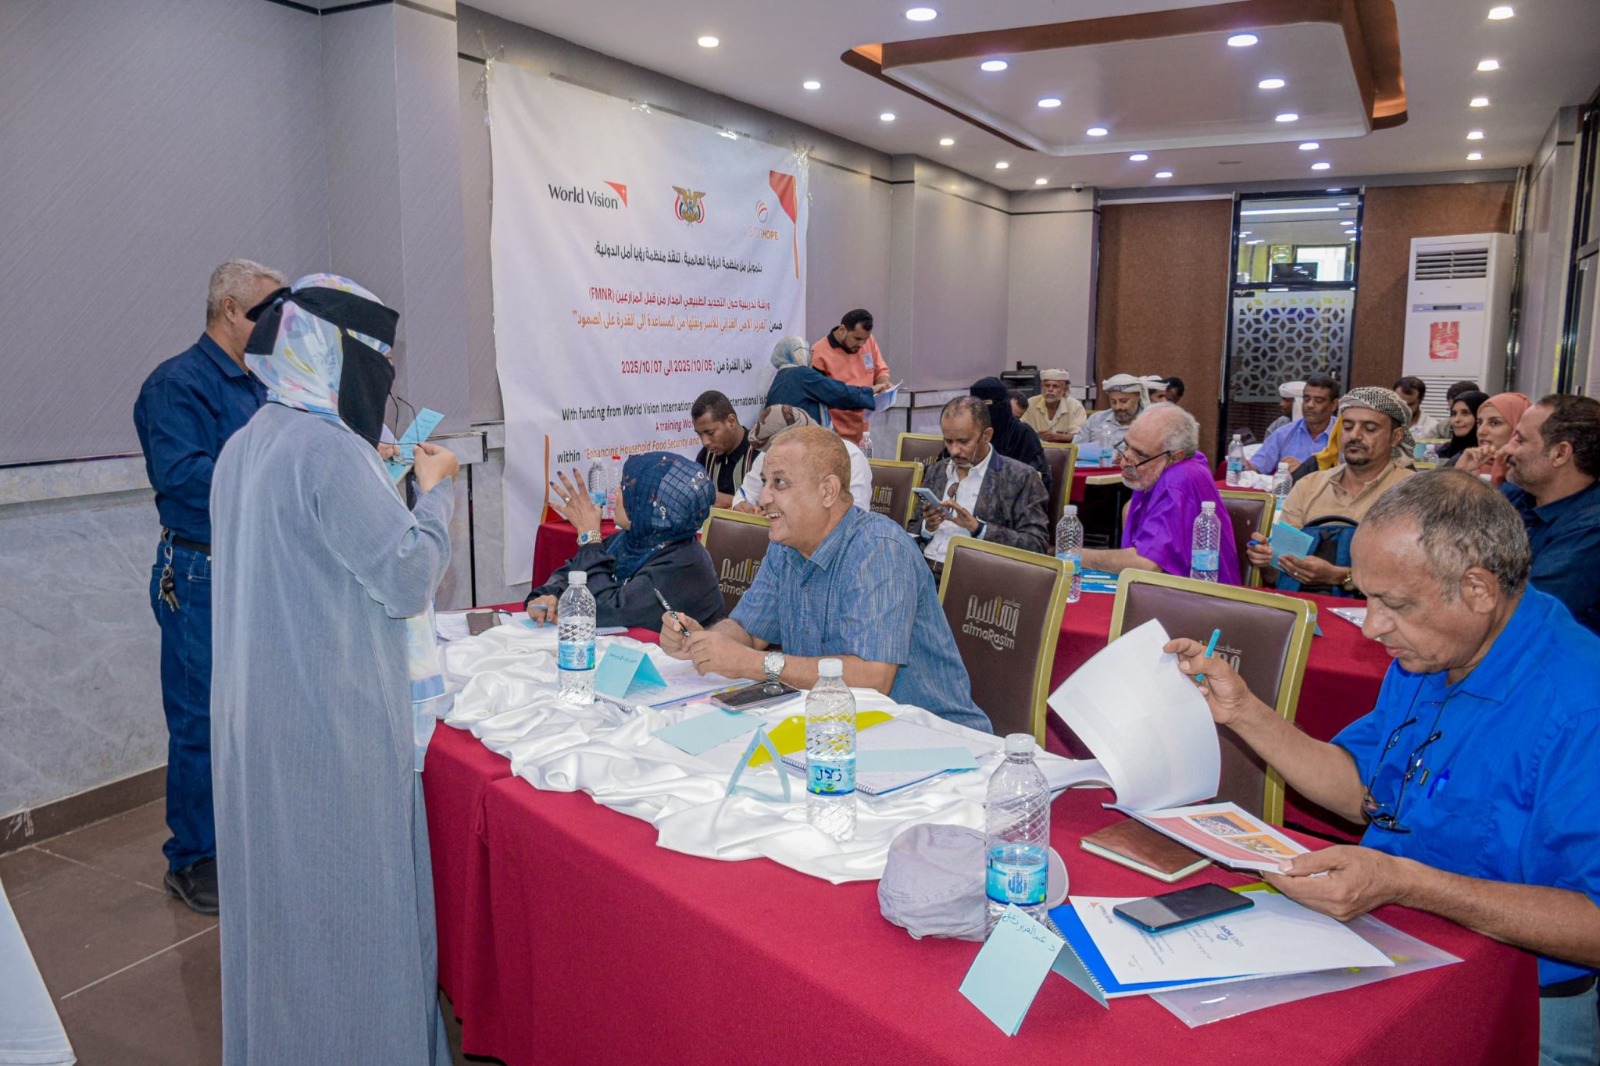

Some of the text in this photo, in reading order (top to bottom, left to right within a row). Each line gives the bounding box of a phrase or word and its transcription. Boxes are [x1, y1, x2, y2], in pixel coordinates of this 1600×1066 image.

[548, 184, 618, 210] World Vision
[646, 246, 666, 263] منظمة
[589, 287, 614, 302] (FMNR)
[645, 292, 656, 305] قبل
[656, 294, 666, 306] من
[603, 312, 616, 329] على
[617, 311, 635, 329] القدرة
[648, 312, 675, 328] المساعدة
[769, 319, 783, 333] ضمن
[621, 360, 662, 375] 2025/10/07
[674, 359, 713, 373] 2025/10/05
[716, 360, 725, 374] من
[726, 358, 740, 373] الفترة
[740, 358, 752, 373] خلال
[562, 407, 578, 421] With
[579, 406, 605, 421] funding
[606, 405, 621, 418] from
[622, 403, 642, 416] World
[643, 402, 660, 415] Vision
[660, 419, 682, 433] training
[557, 450, 580, 464] within
[620, 441, 651, 455] Household
[652, 440, 666, 451] Food
[667, 438, 688, 450] Security
